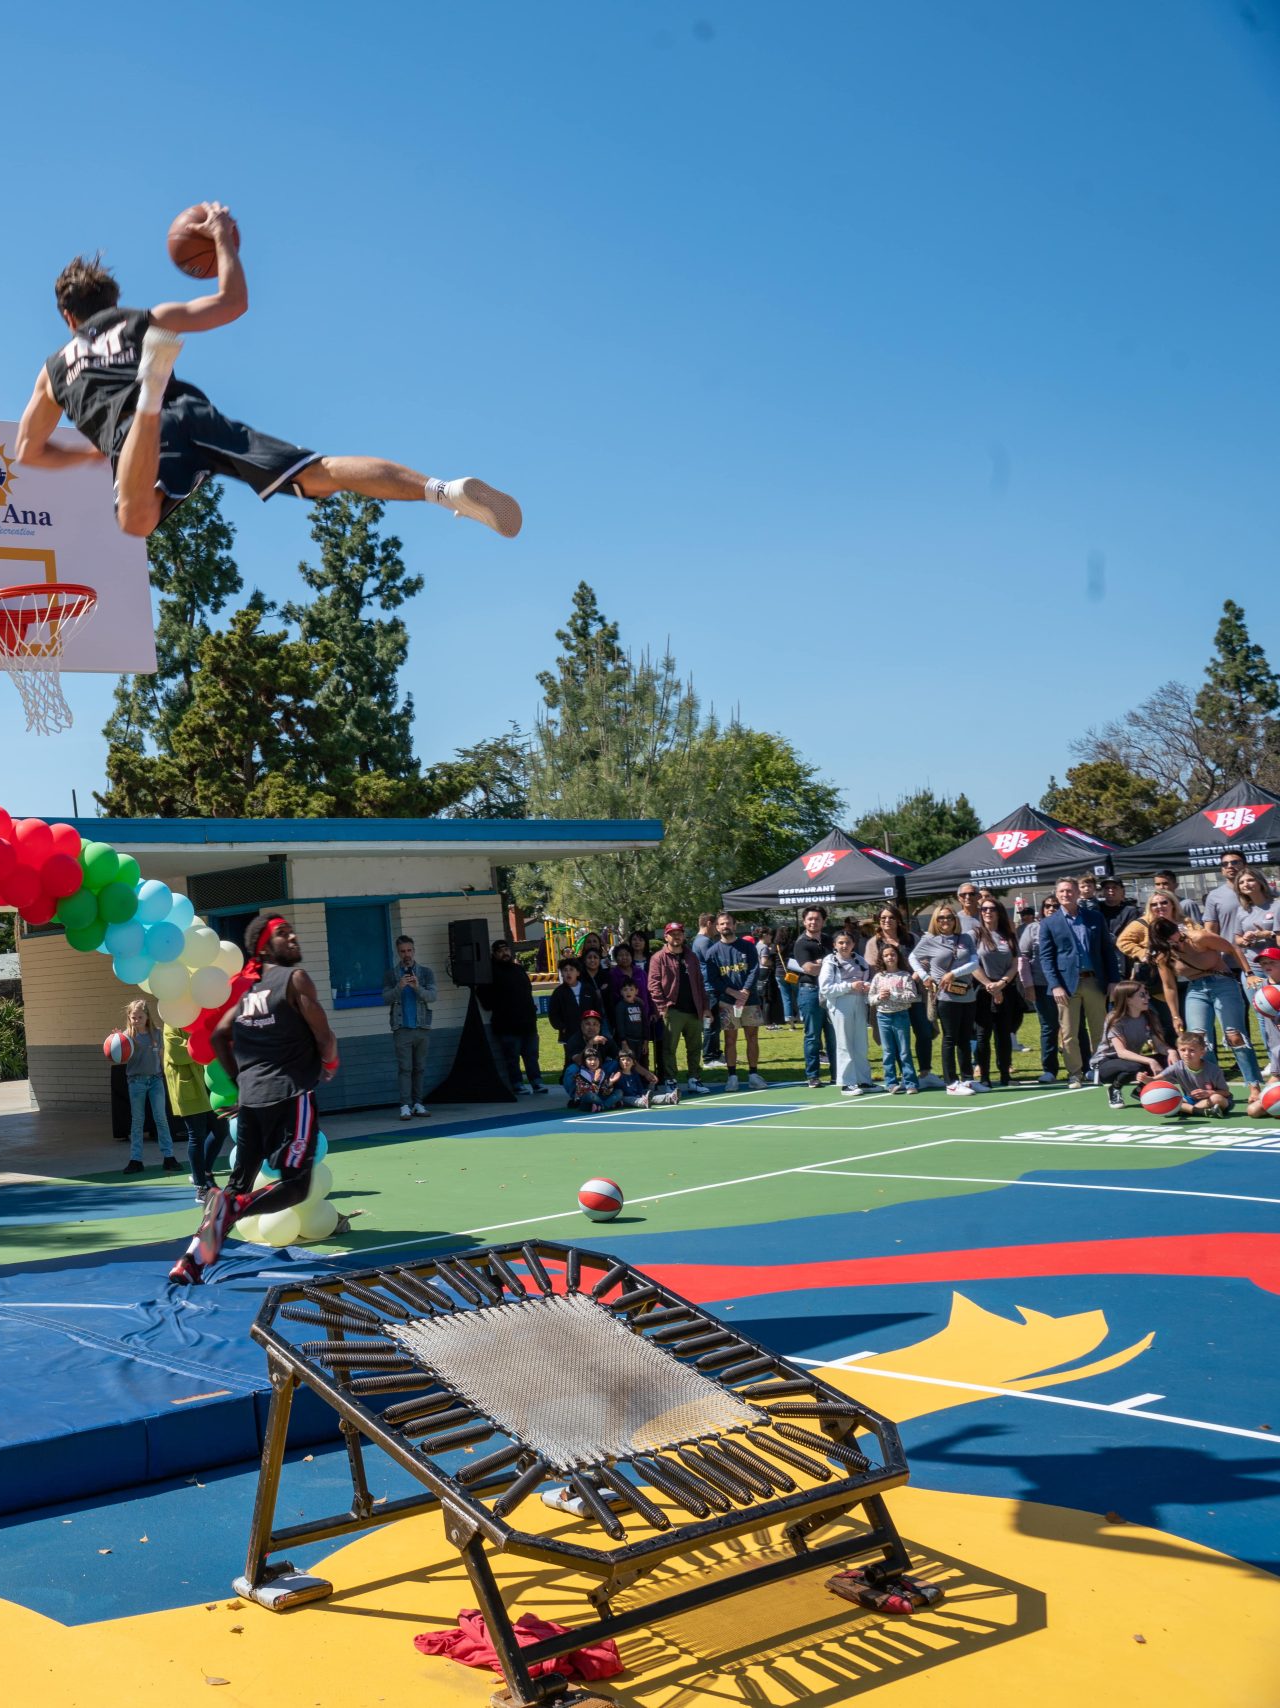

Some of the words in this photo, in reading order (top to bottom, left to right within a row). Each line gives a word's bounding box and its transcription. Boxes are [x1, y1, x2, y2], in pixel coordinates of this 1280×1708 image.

[2, 503, 53, 526] Ana
[1212, 807, 1256, 831] BJ's
[991, 831, 1029, 853] BJ's
[1188, 842, 1267, 856] RESTAURANT
[803, 851, 837, 873] BJ's
[1190, 854, 1269, 868] BREWUSE
[970, 864, 1036, 878] RESTAURANT
[778, 884, 836, 895] RESTAURANT
[779, 896, 837, 905] BREWHOUSE
